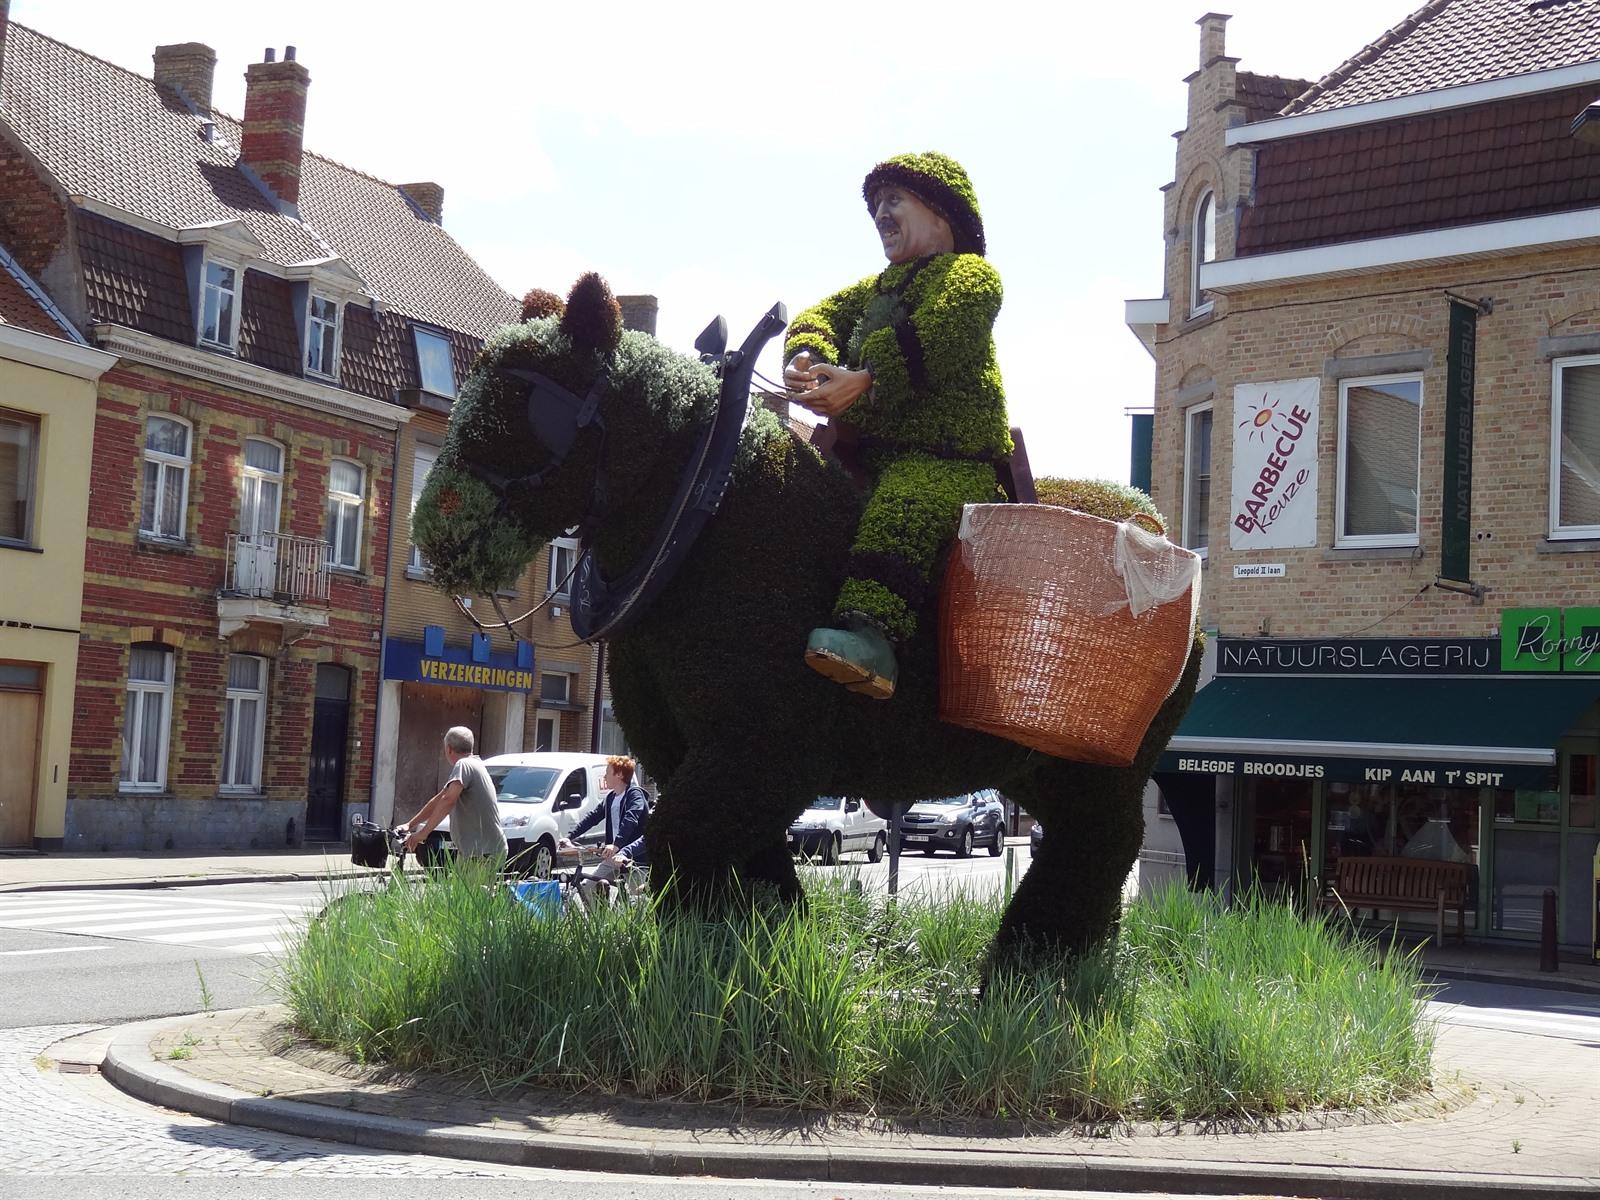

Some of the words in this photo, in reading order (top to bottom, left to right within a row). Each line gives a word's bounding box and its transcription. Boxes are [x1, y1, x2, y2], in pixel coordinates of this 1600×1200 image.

[1456, 321, 1474, 522] NATUURSLAGERIJ
[1234, 404, 1311, 534] BARBECUE
[1237, 566, 1259, 576] Leopold
[1514, 615, 1600, 666] Ronny
[1224, 645, 1489, 668] NATUURSLAGERIJ
[420, 659, 533, 689] VERZEKERINGEN
[1178, 758, 1235, 773] BELEGDE
[1243, 761, 1325, 778] BROODJES
[1365, 767, 1392, 781] KIP
[1400, 769, 1436, 783] AAN
[1465, 772, 1504, 786] SPIT
